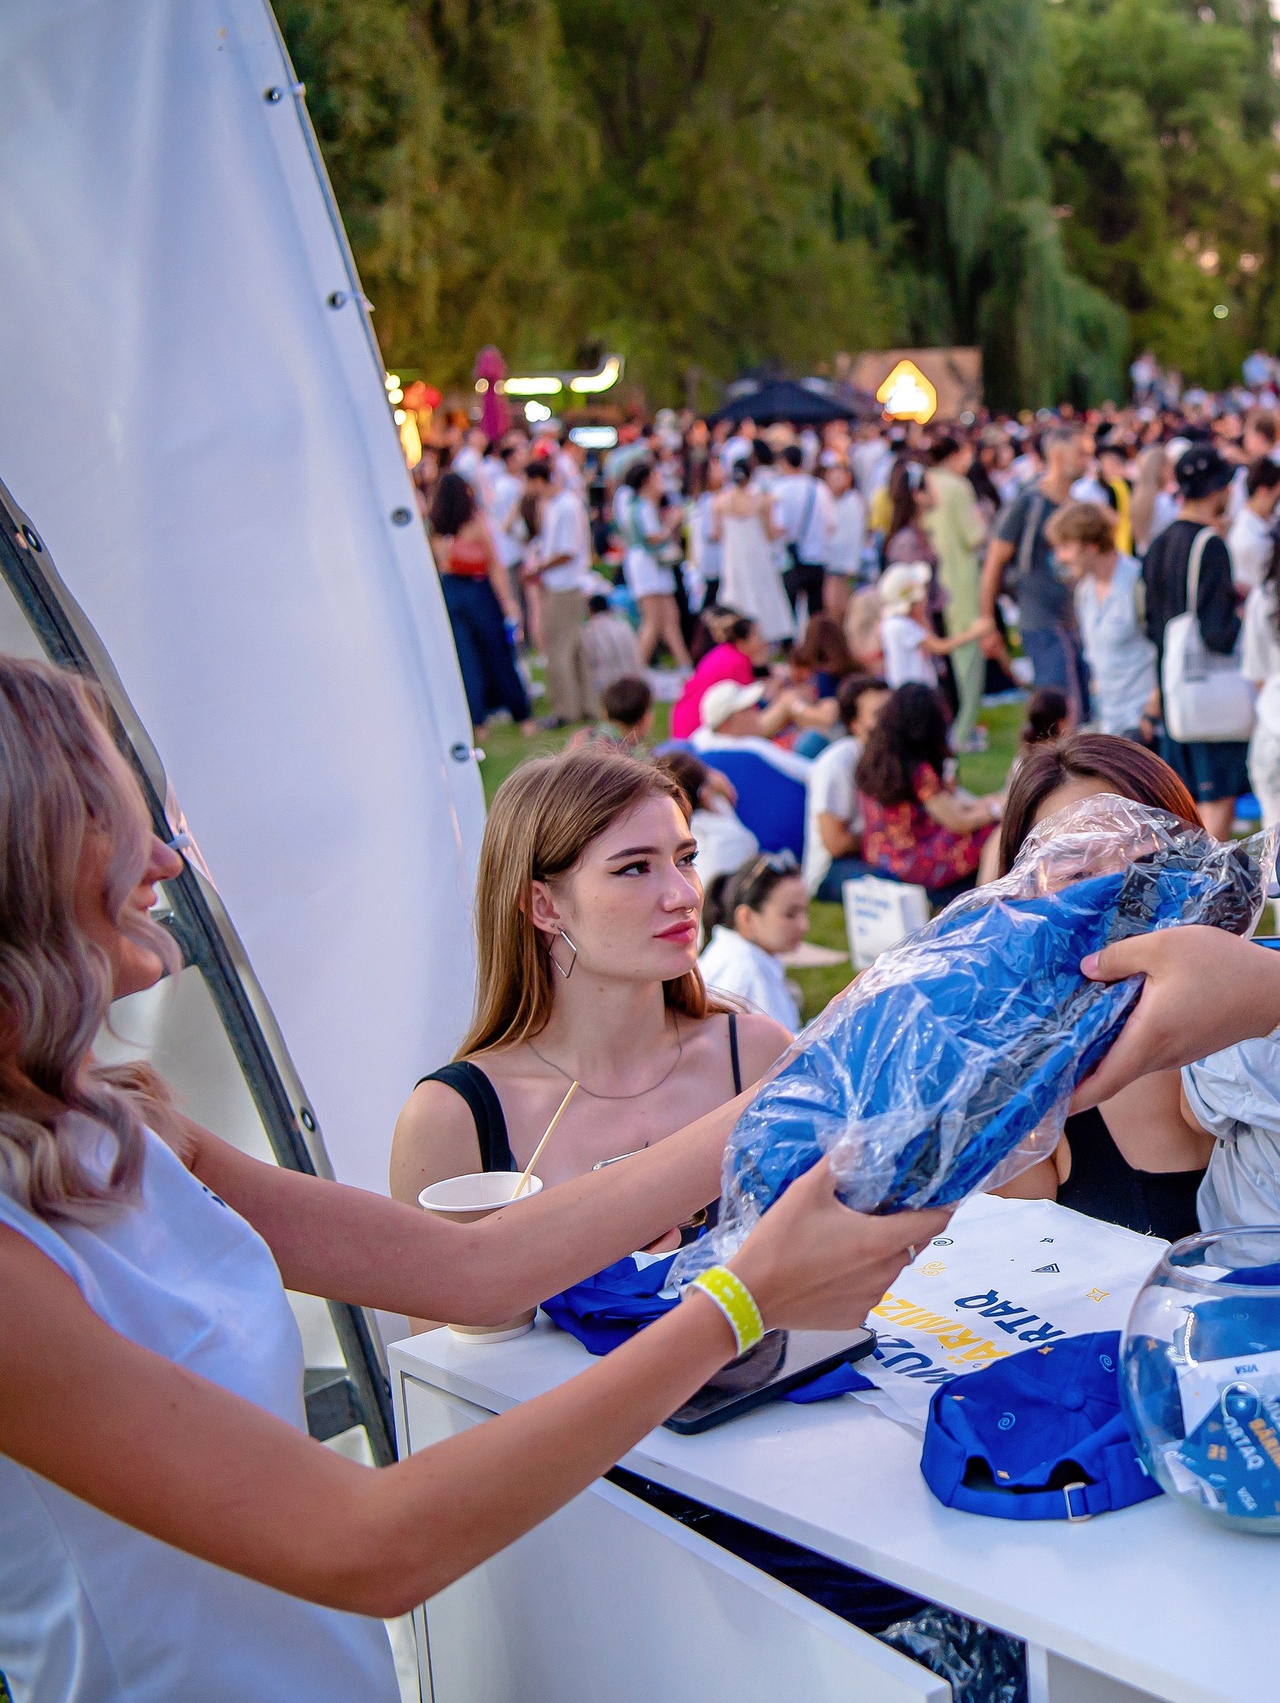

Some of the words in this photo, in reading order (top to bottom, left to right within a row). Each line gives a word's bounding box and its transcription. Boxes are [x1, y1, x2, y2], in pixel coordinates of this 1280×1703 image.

[954, 1289, 1066, 1342] RTAQ
[1234, 1363, 1259, 1375] VISA
[1223, 1416, 1264, 1471] ORTAQ
